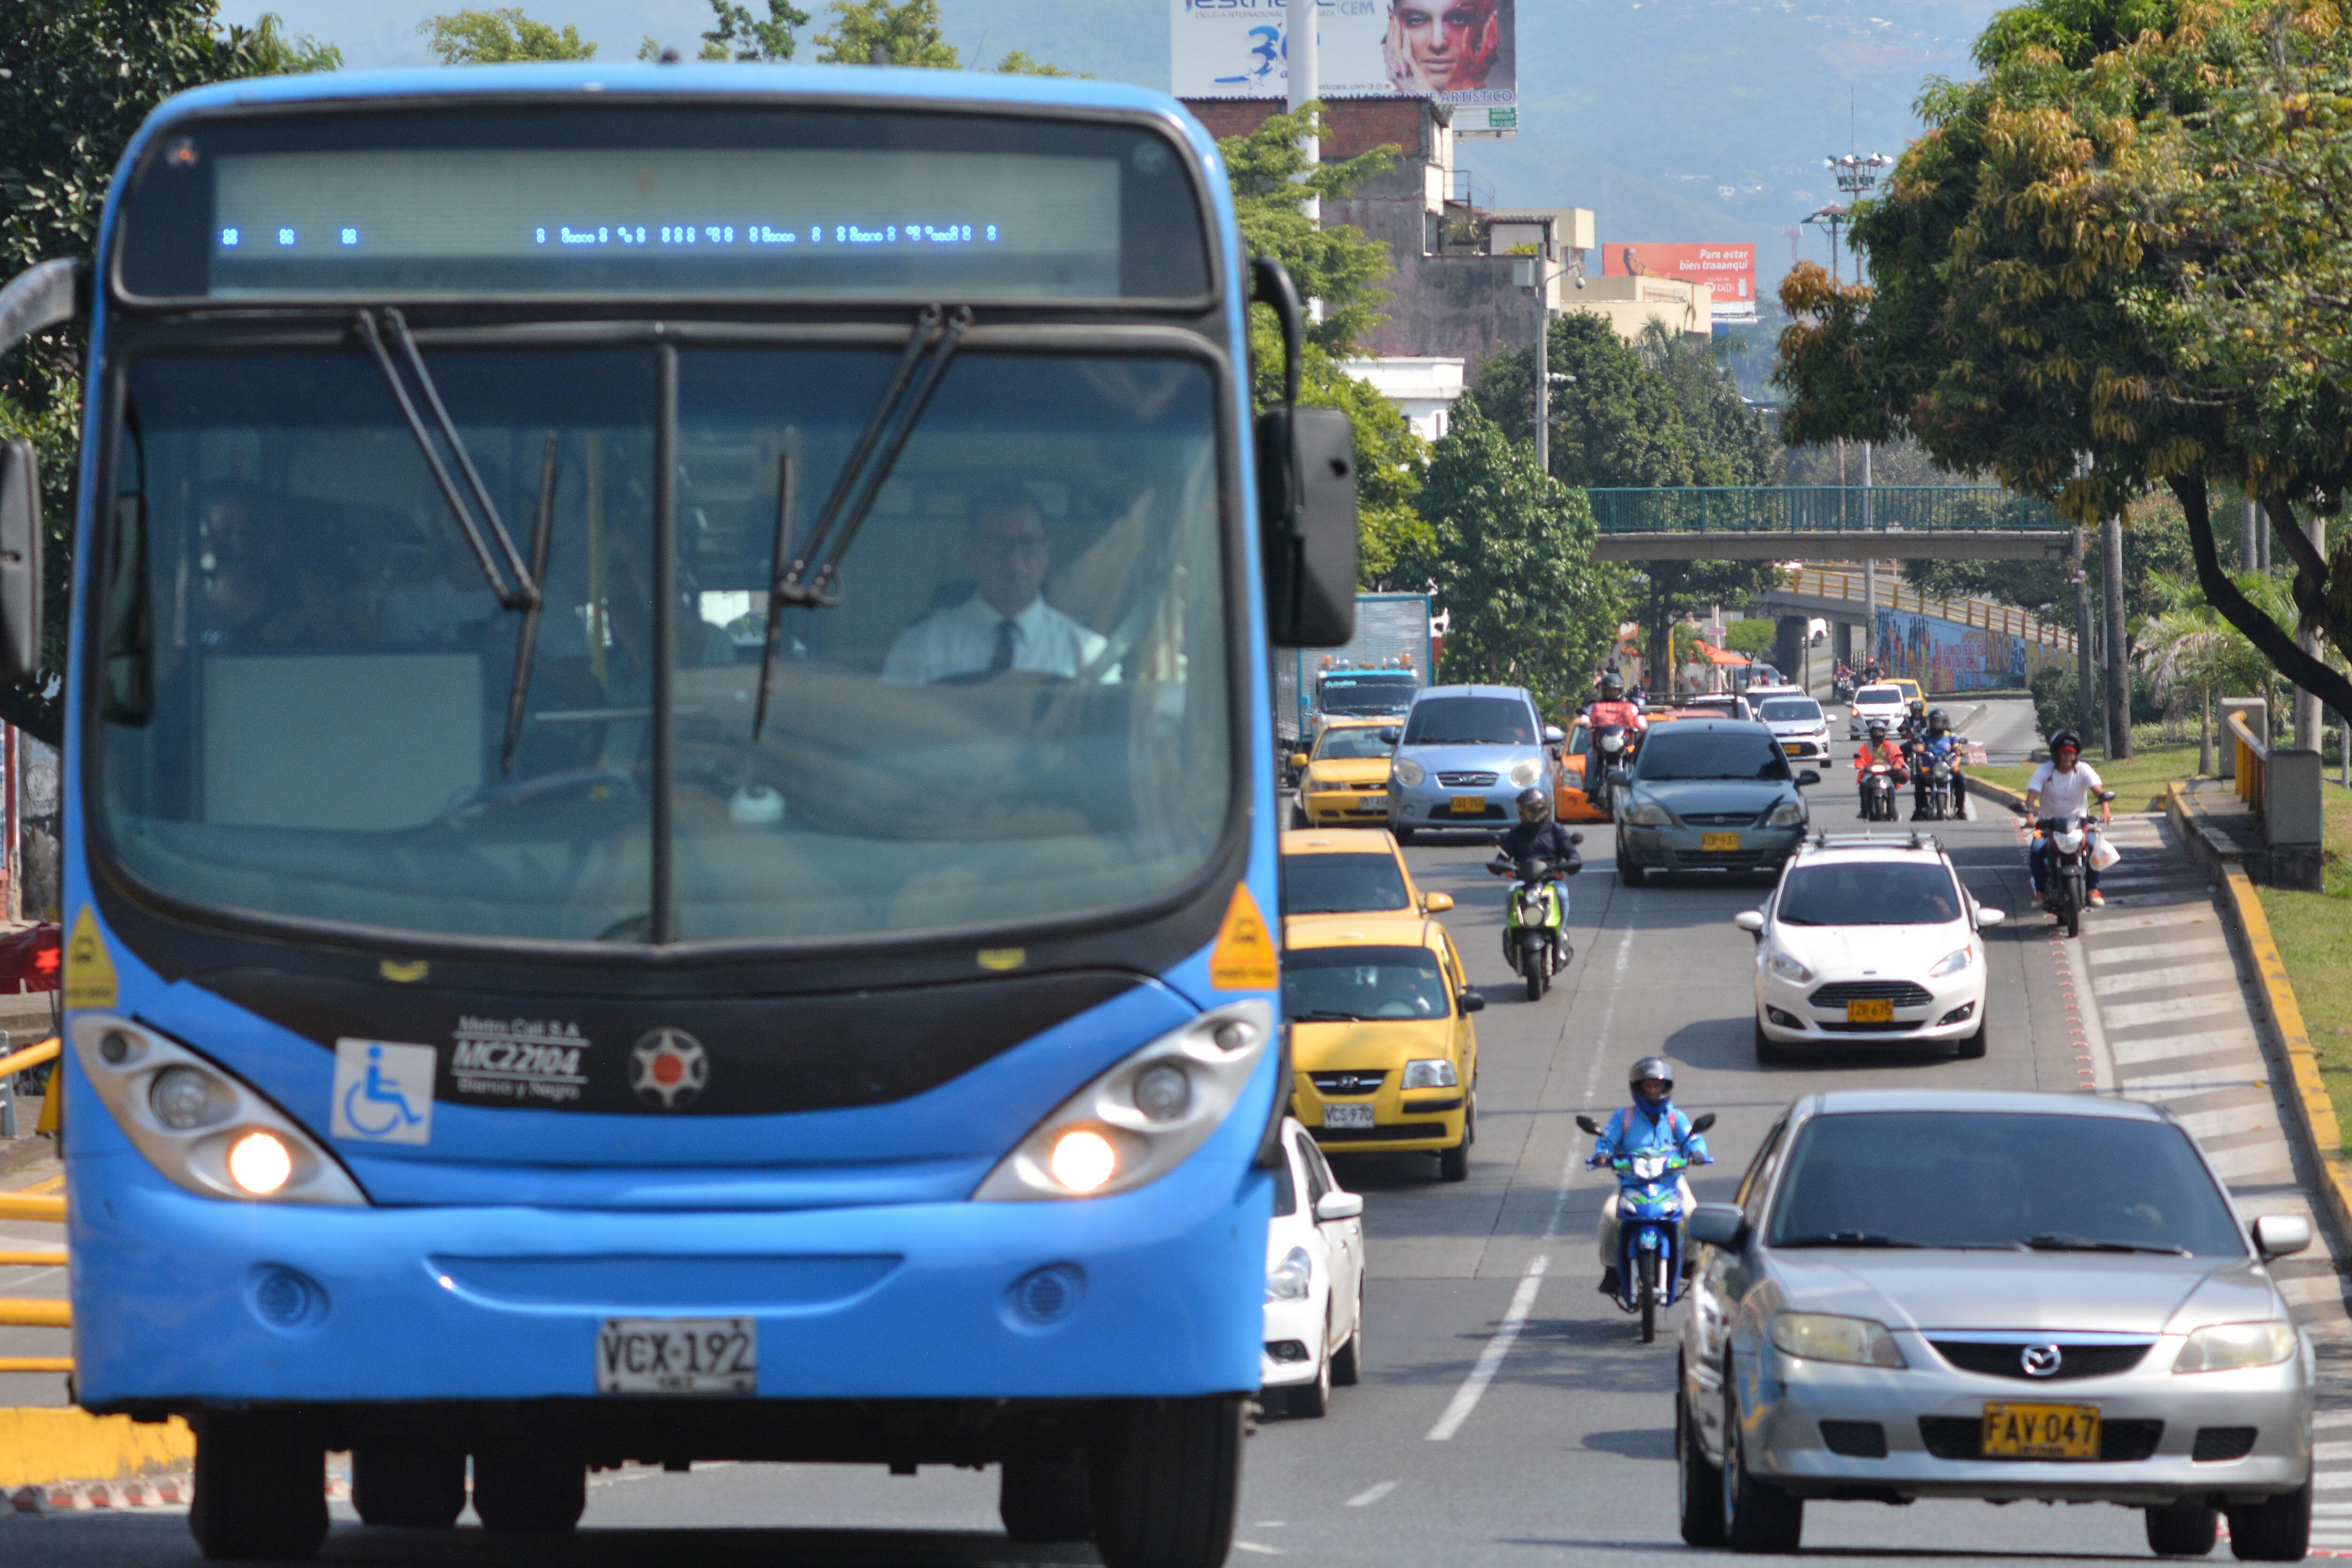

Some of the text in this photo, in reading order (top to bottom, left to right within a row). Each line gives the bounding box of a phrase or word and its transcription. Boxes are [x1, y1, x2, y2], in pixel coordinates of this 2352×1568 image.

[1341, 1, 1375, 15] CEM
[1441, 88, 1513, 103] ARTÍSTICO
[1700, 249, 1748, 259] Para estar
[1679, 259, 1748, 271] bien traaanqui
[452, 1040, 581, 1074] MC22104
